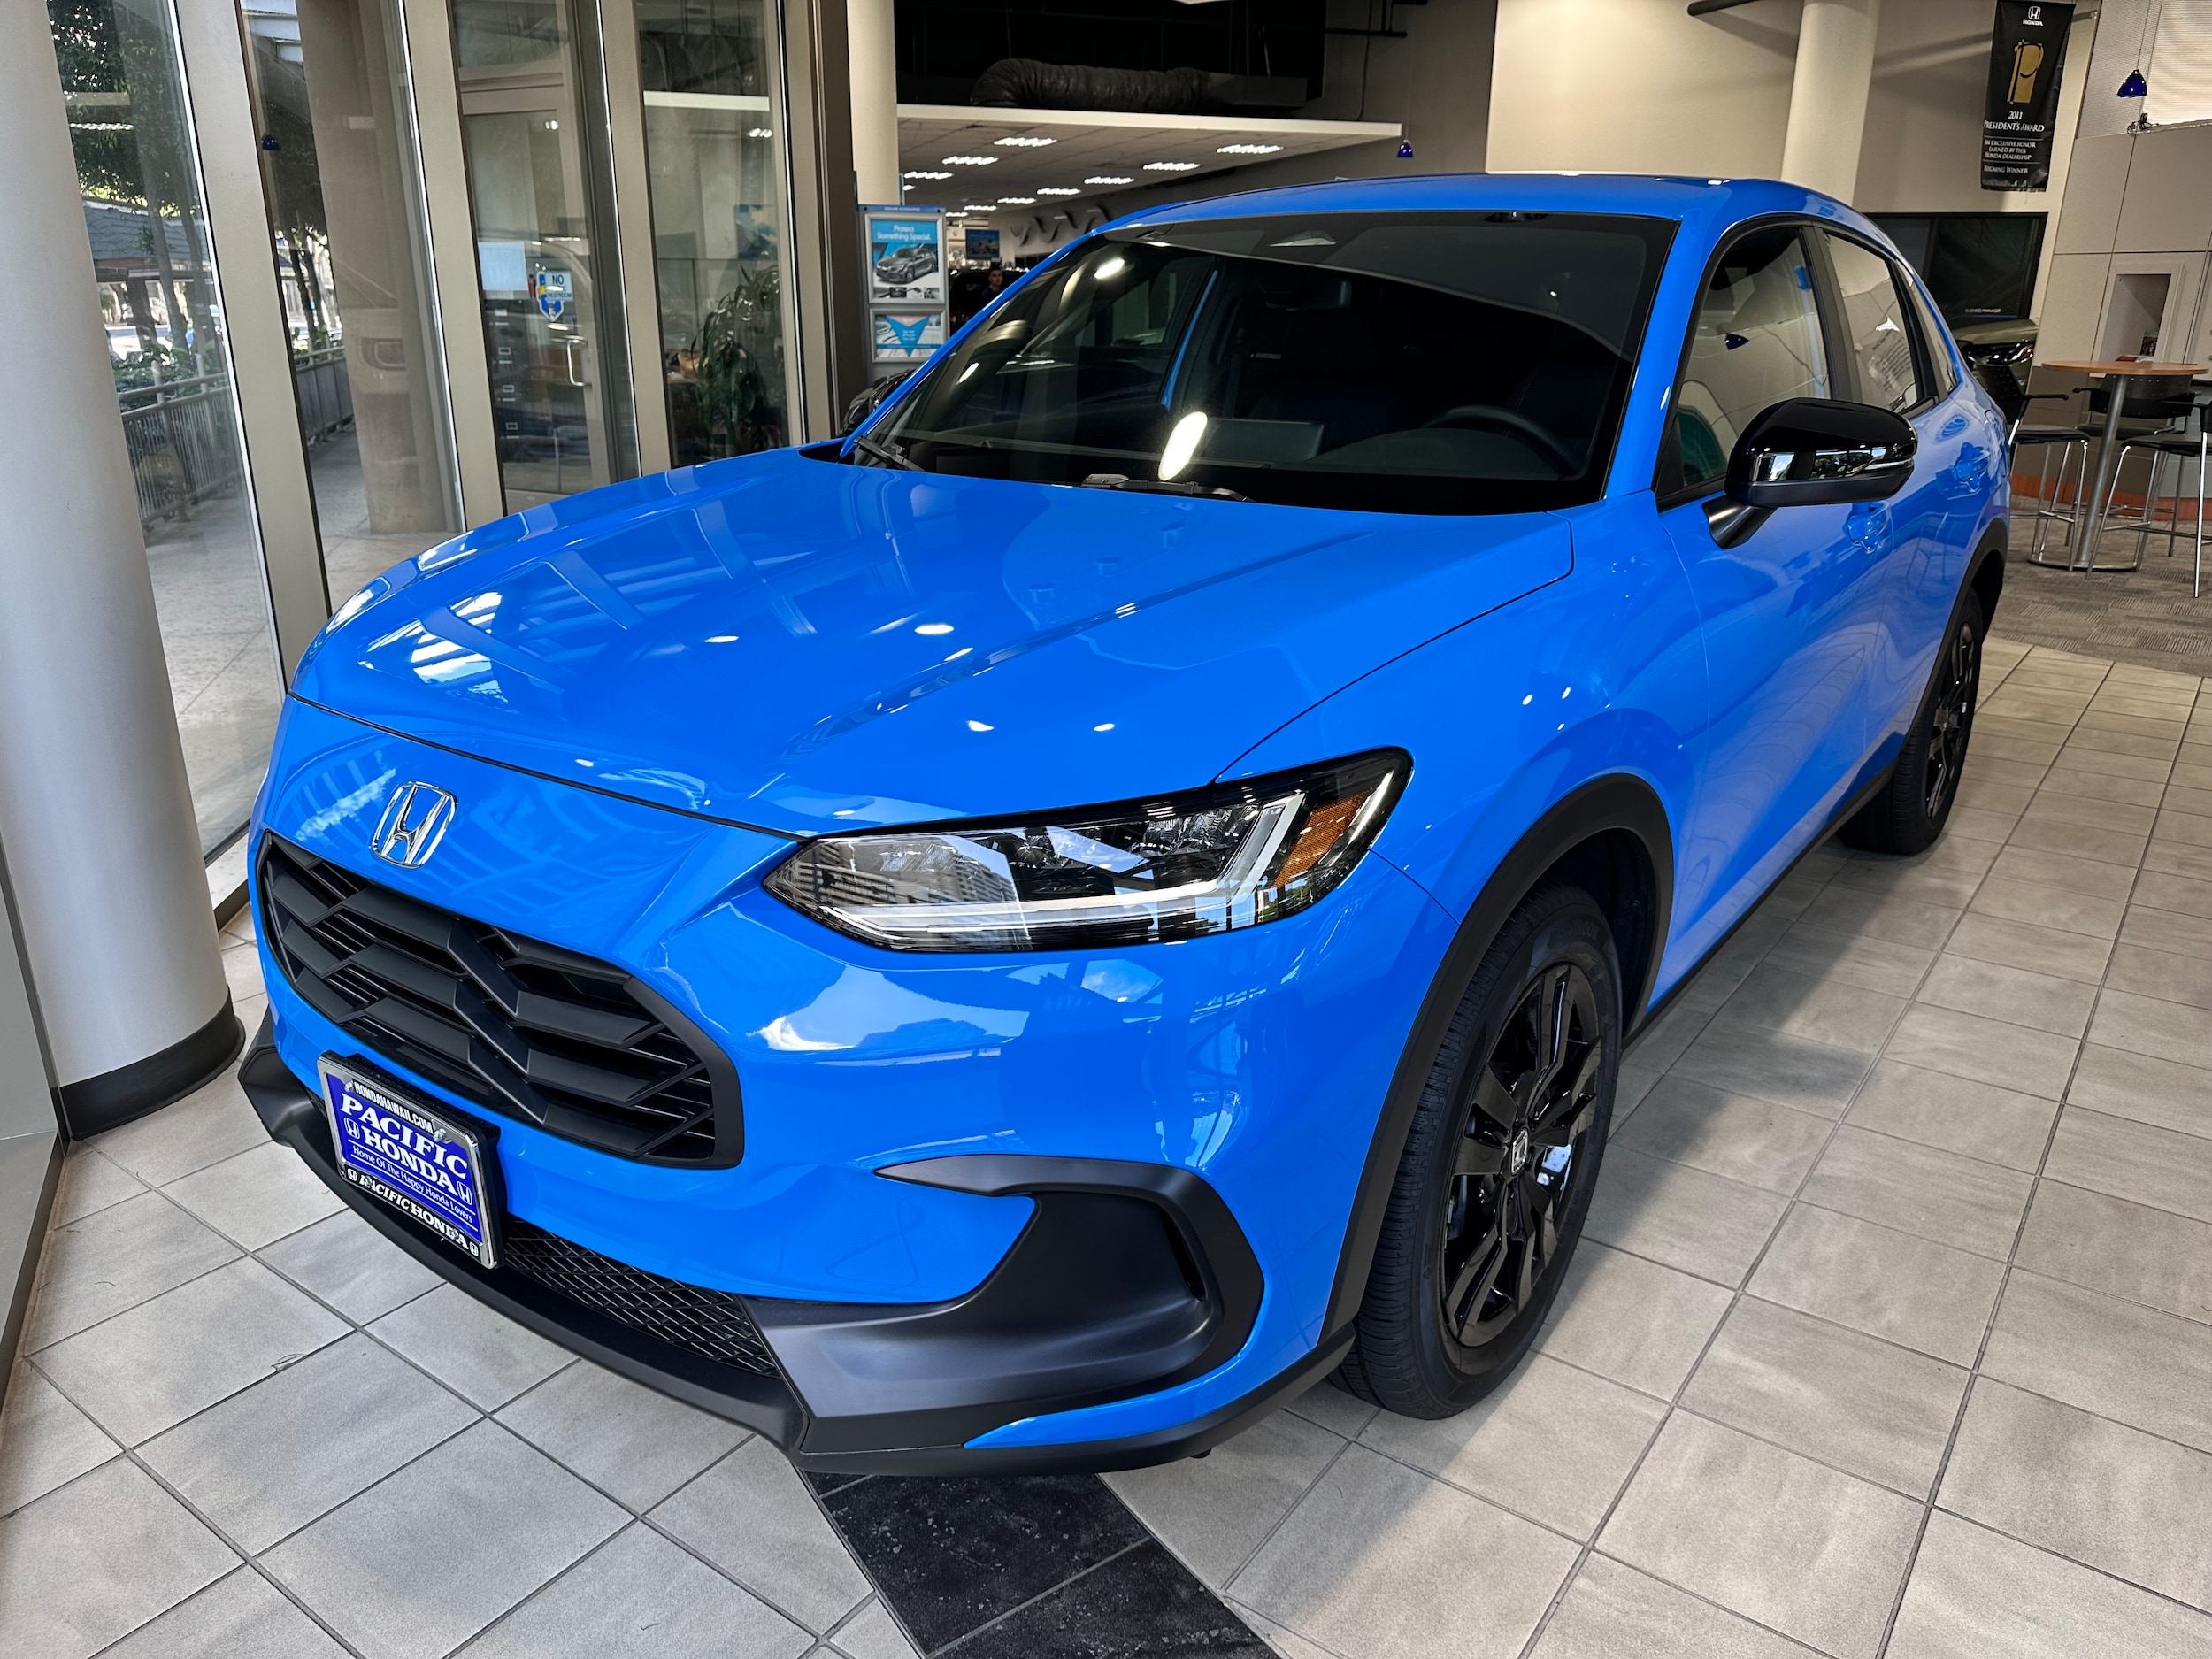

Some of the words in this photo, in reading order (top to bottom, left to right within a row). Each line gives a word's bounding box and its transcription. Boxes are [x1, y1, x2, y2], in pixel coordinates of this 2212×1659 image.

[2008, 111, 2024, 119] 2011
[2020, 123, 2045, 133] AWARD
[877, 232, 910, 242] Something
[552, 275, 564, 284] NO
[354, 1081, 434, 1134] HONDAHAWAII.COM
[340, 1093, 468, 1179] PACIFIC
[353, 1145, 375, 1164] Home
[376, 1157, 386, 1169] Of
[387, 1163, 400, 1177] The
[400, 1172, 424, 1194] Happy
[425, 1185, 449, 1207] Honda
[450, 1201, 473, 1223] Lovers
[361, 1125, 458, 1196] HONDA
[410, 1202, 469, 1250] HONDA
